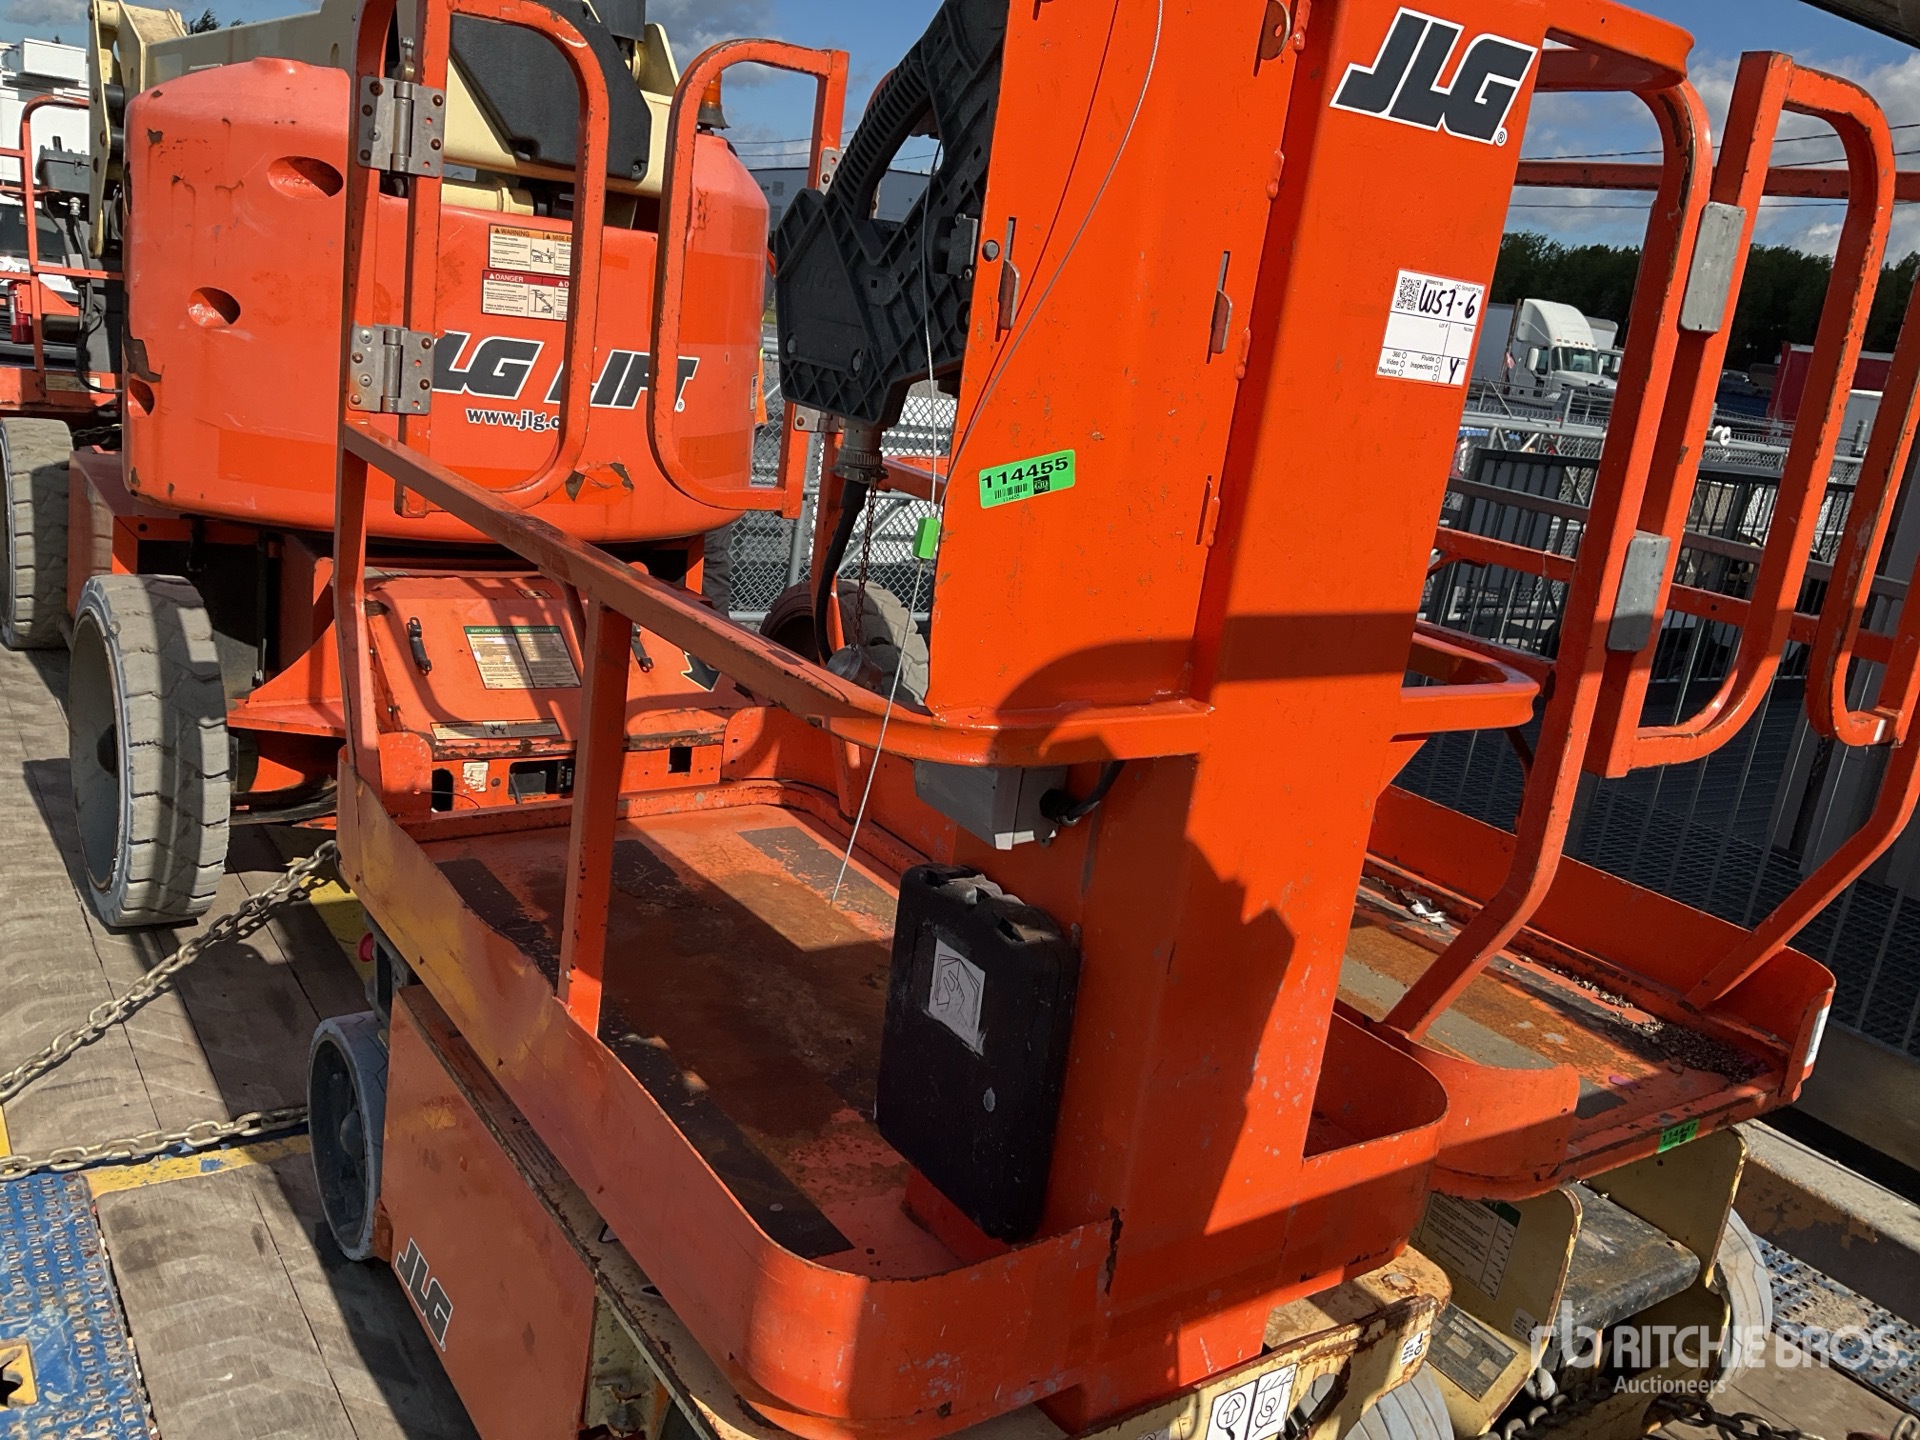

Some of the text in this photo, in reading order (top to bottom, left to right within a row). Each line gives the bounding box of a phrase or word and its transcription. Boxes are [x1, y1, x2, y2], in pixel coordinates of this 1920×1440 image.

[500, 228, 530, 237] WARNING
[495, 273, 524, 283] DANGER
[1386, 358, 1399, 366] Video
[1420, 355, 1435, 363] Fluids
[431, 329, 545, 400] LG
[1410, 361, 1434, 371] Inspection
[467, 408, 561, 432] www.jlg.c
[982, 456, 1069, 489] 114455
[395, 1237, 454, 1347] JLG
